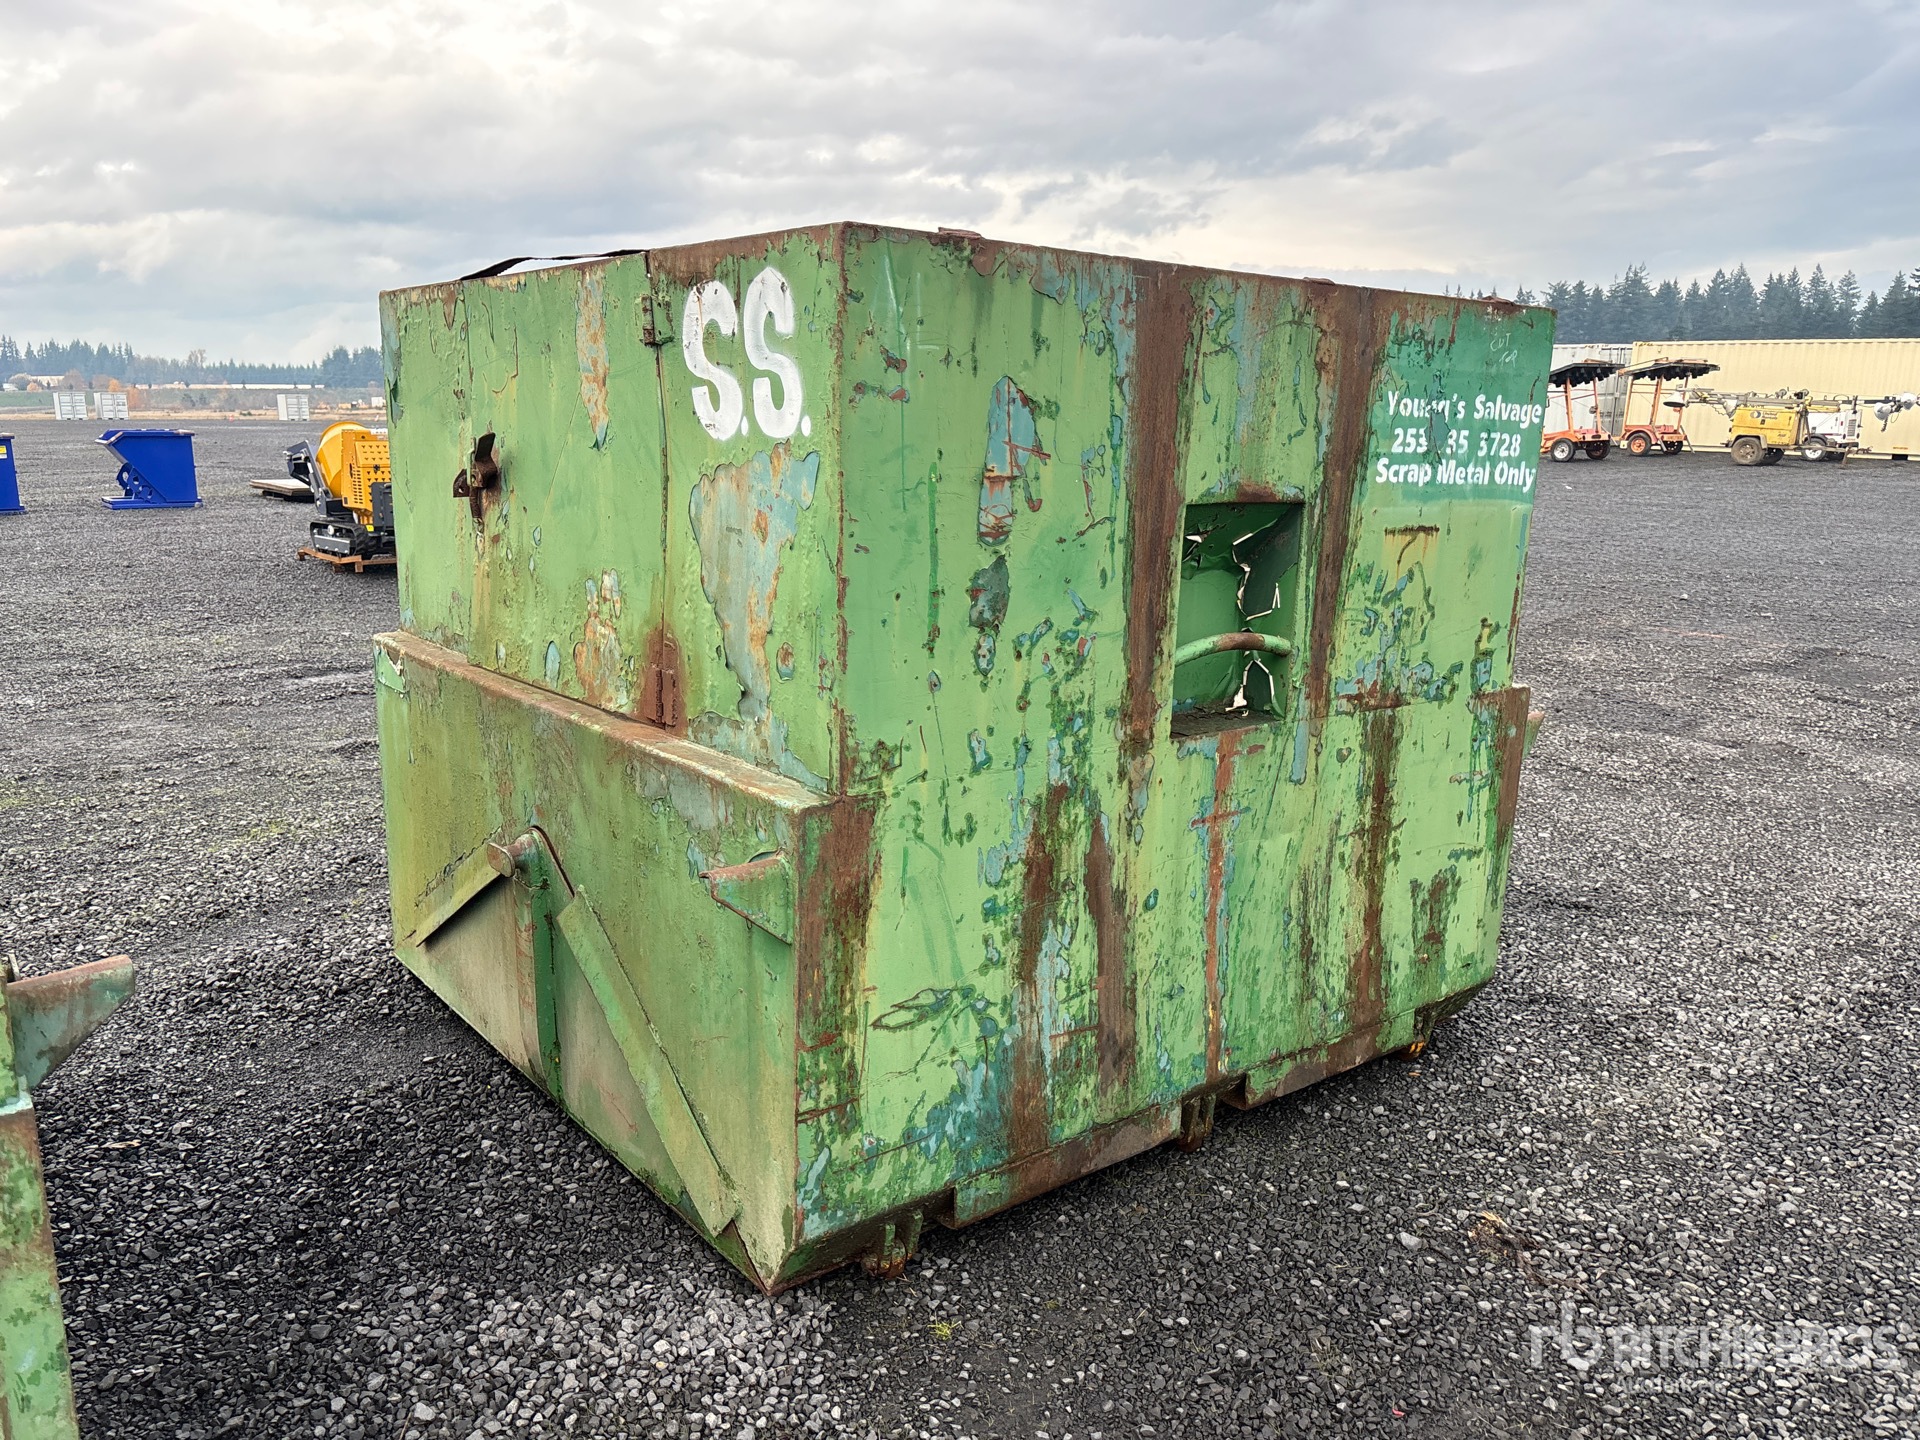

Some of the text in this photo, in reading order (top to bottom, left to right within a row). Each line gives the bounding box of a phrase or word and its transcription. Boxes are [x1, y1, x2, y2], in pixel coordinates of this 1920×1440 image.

[682, 266, 811, 441] S.S.
[1474, 394, 1542, 429] Salvage
[1391, 427, 1521, 458] 253 35 3728
[1375, 457, 1537, 493] Scrap Metal Only
